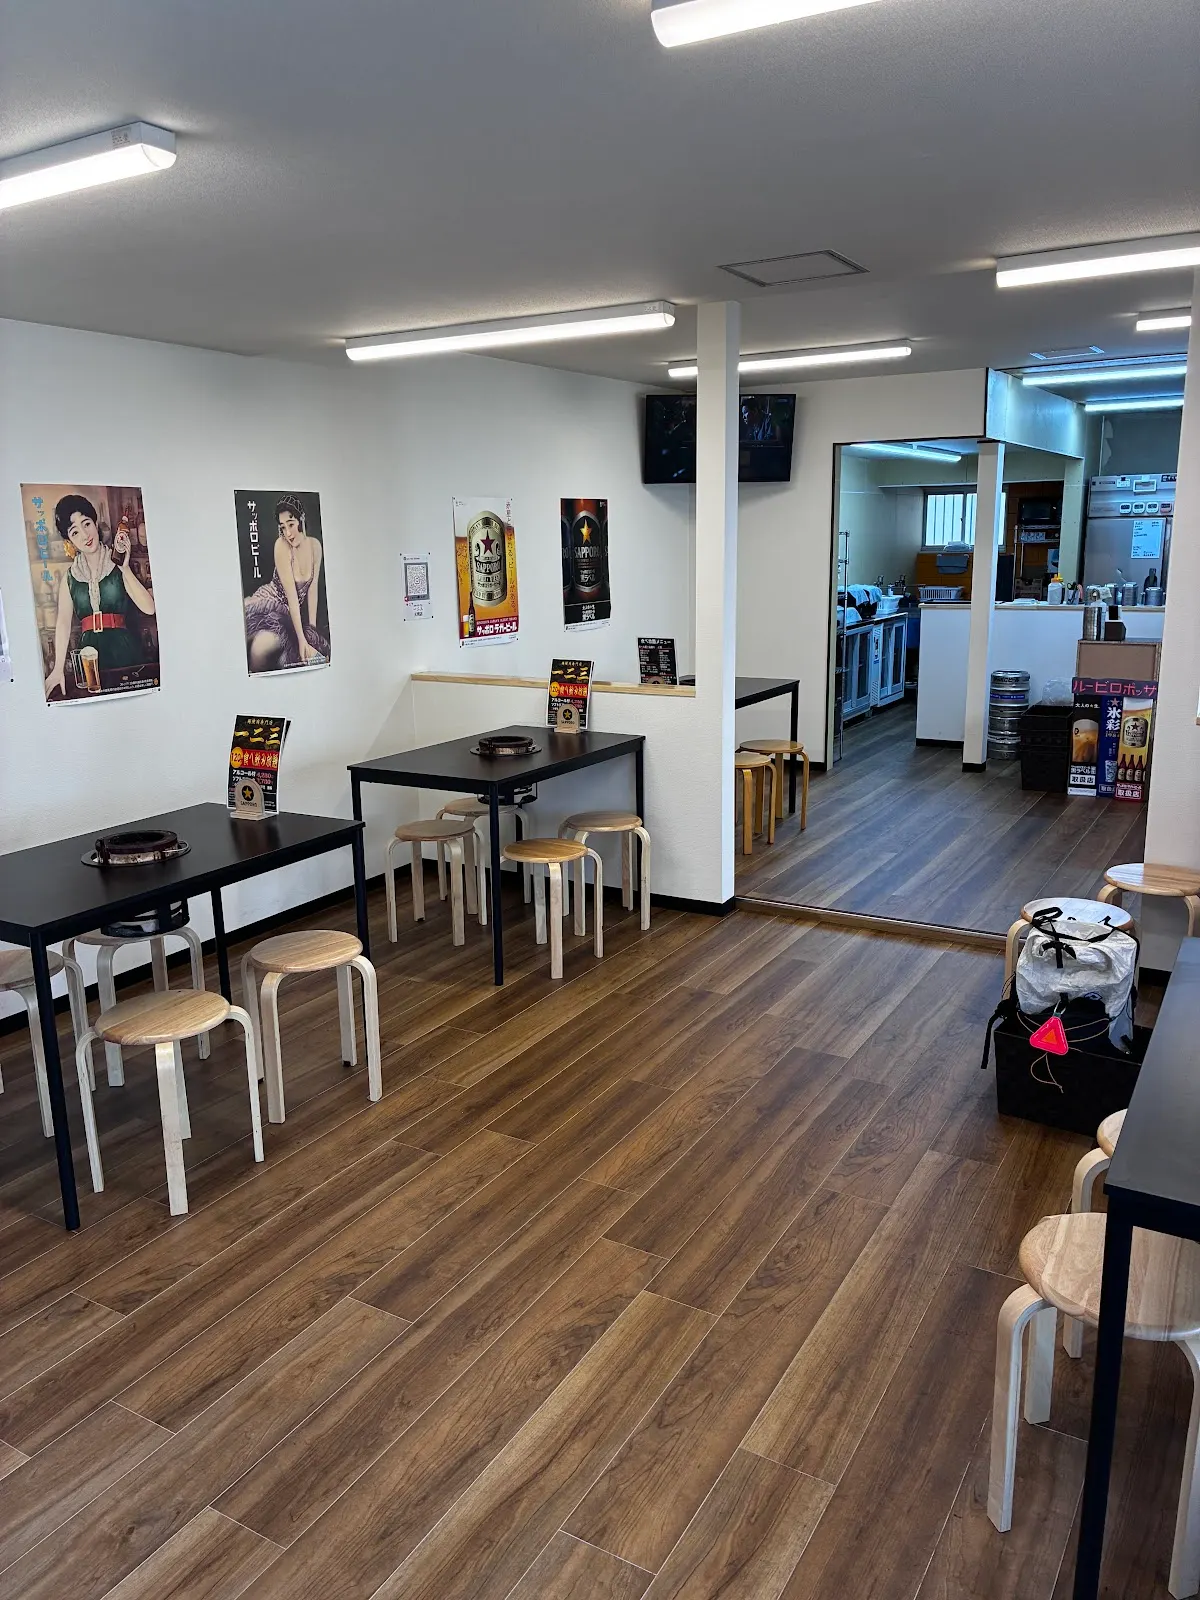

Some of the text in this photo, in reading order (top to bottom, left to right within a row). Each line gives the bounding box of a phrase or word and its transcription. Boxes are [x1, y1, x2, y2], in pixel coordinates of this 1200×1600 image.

[31, 496, 53, 582] サッポロビール
[247, 500, 262, 578] サッポロビール
[234, 726, 281, 745] 一二三
[1106, 707, 1121, 730] 氷彩
